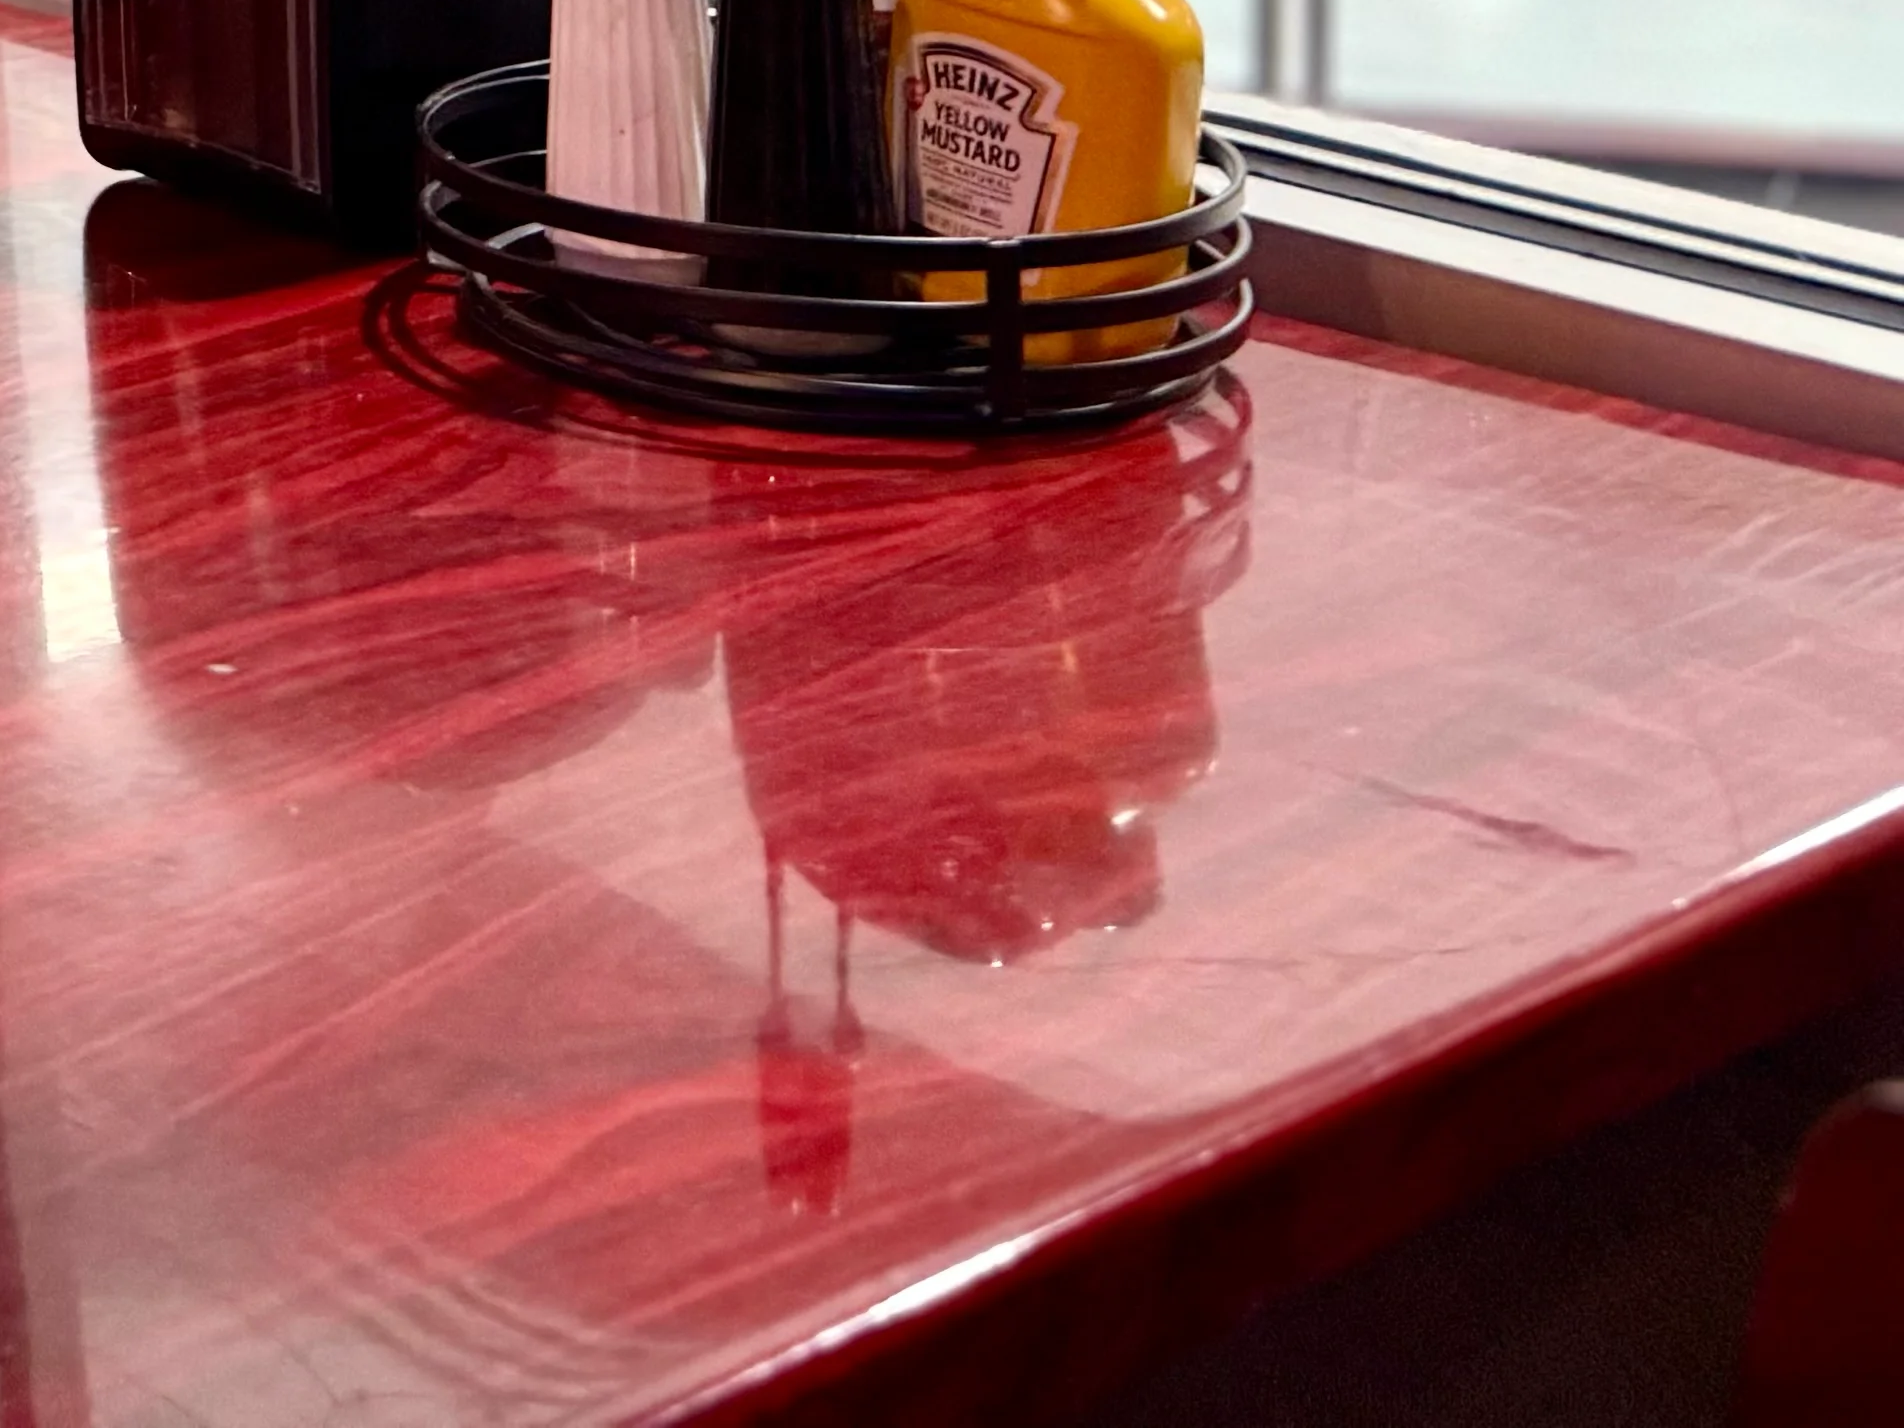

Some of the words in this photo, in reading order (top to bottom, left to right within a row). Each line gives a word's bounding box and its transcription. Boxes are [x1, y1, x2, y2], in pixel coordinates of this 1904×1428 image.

[934, 61, 1019, 111] HEINZ
[921, 120, 1021, 172] MUSTARD
[935, 100, 1010, 142] YELLOW
